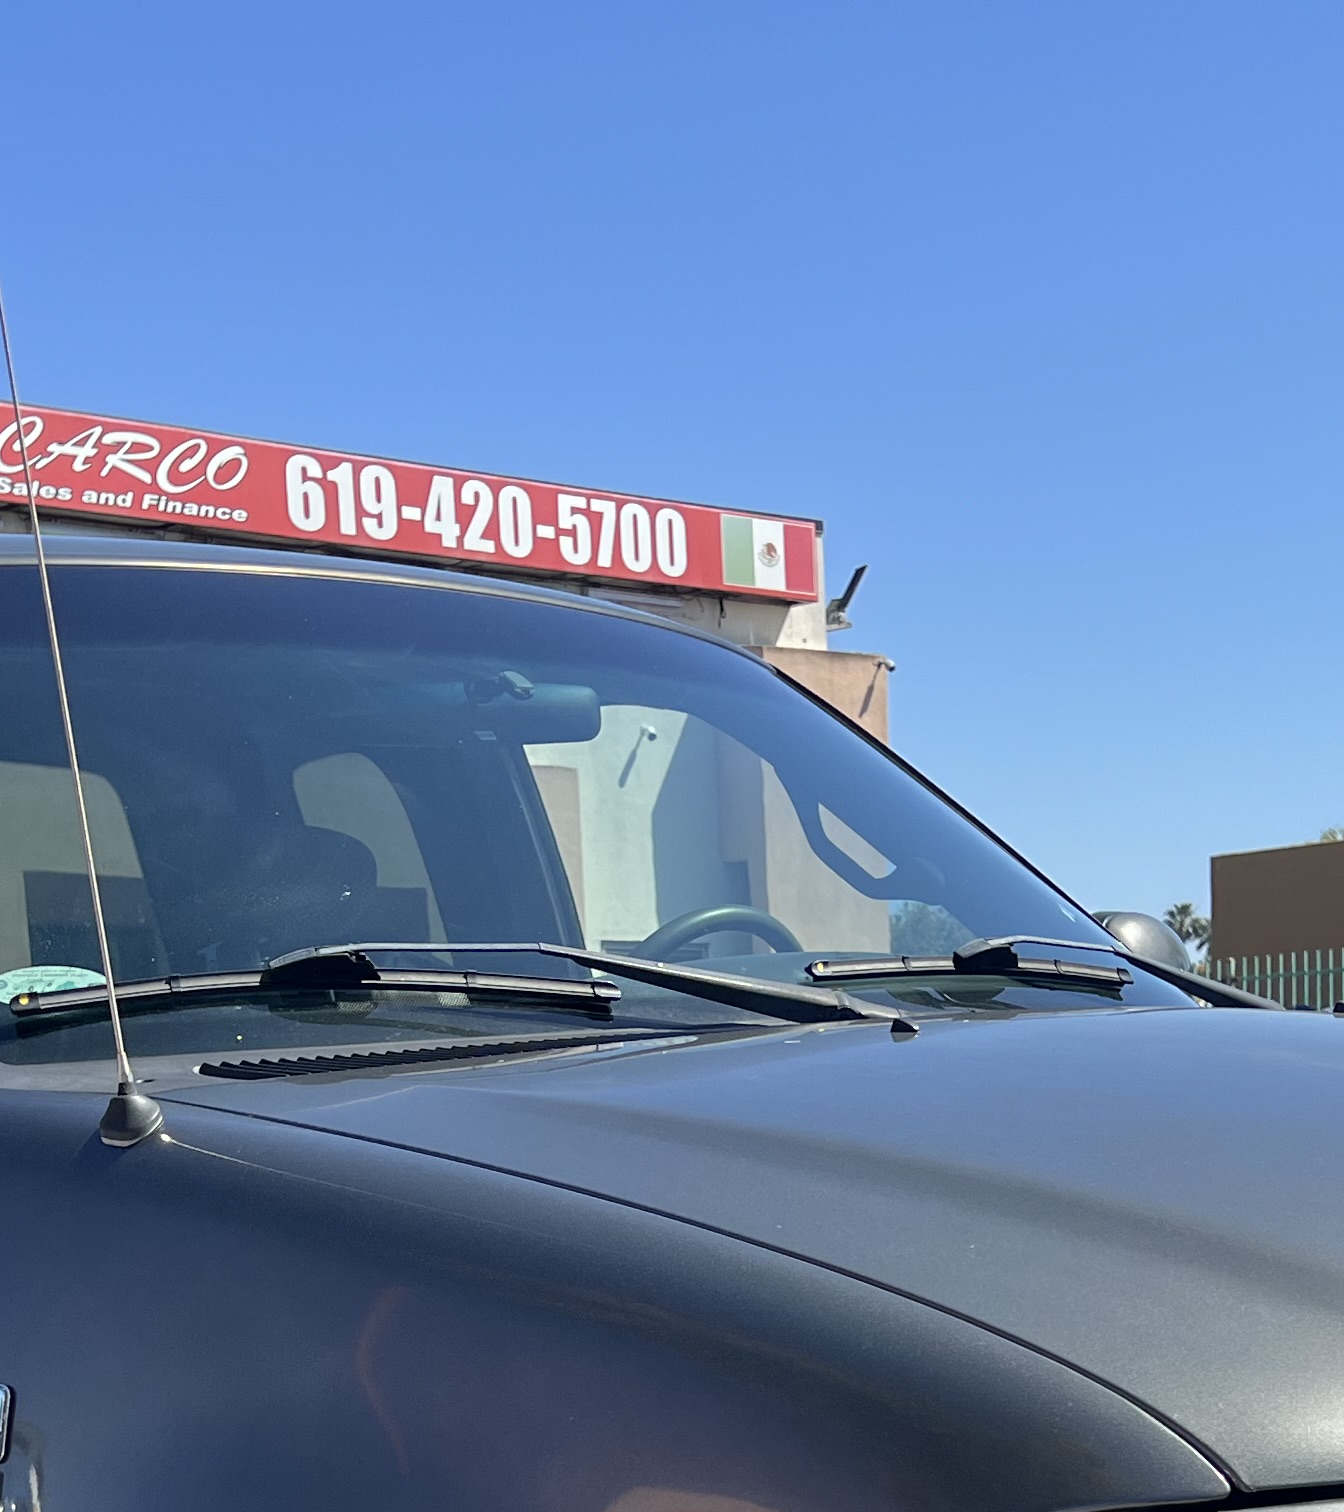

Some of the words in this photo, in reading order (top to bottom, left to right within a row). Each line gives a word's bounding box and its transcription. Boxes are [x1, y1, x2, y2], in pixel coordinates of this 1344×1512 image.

[82, 485, 134, 509] and
[142, 494, 249, 524] Finance
[285, 454, 687, 577] 619-420-5700
